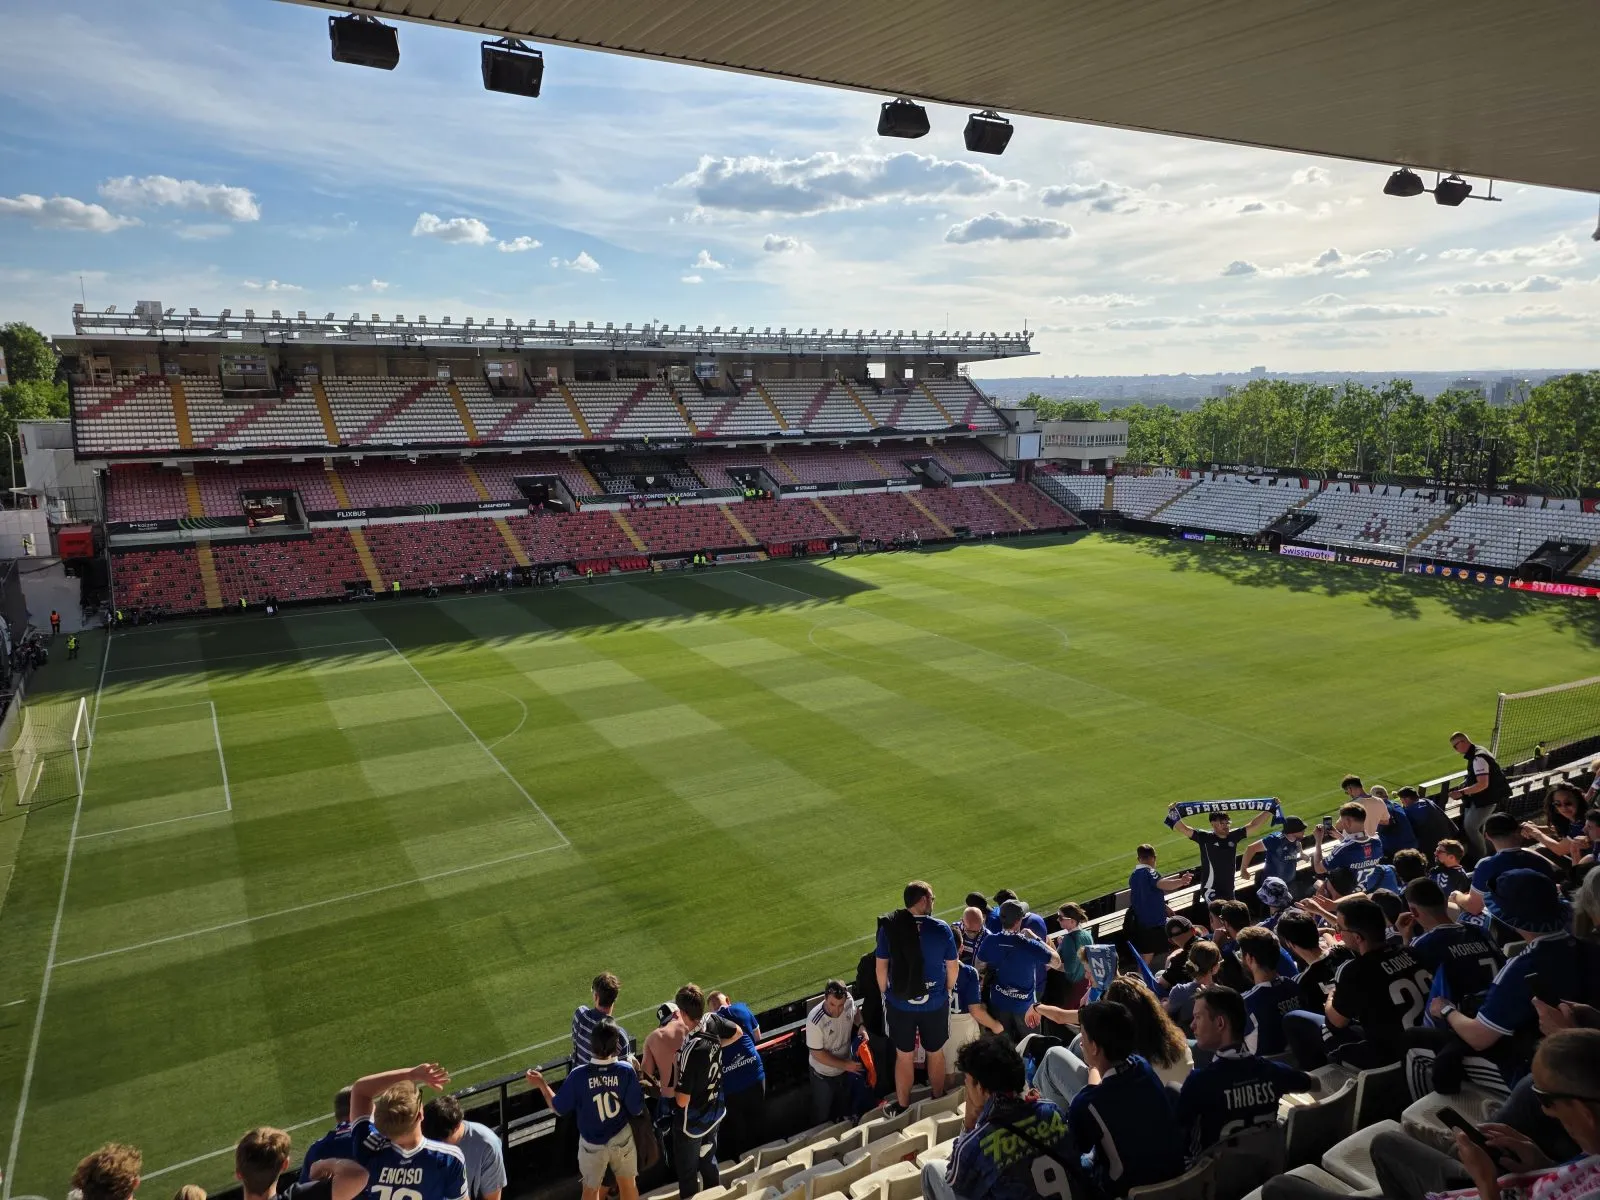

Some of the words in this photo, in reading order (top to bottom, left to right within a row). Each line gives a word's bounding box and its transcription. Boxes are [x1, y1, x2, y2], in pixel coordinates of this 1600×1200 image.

[1282, 545, 1331, 560] Swissquote
[1531, 581, 1587, 598] STRAUSS
[1186, 802, 1272, 816] STRASBOURG
[592, 1091, 621, 1123] 10
[379, 1166, 423, 1185] ENCISO
